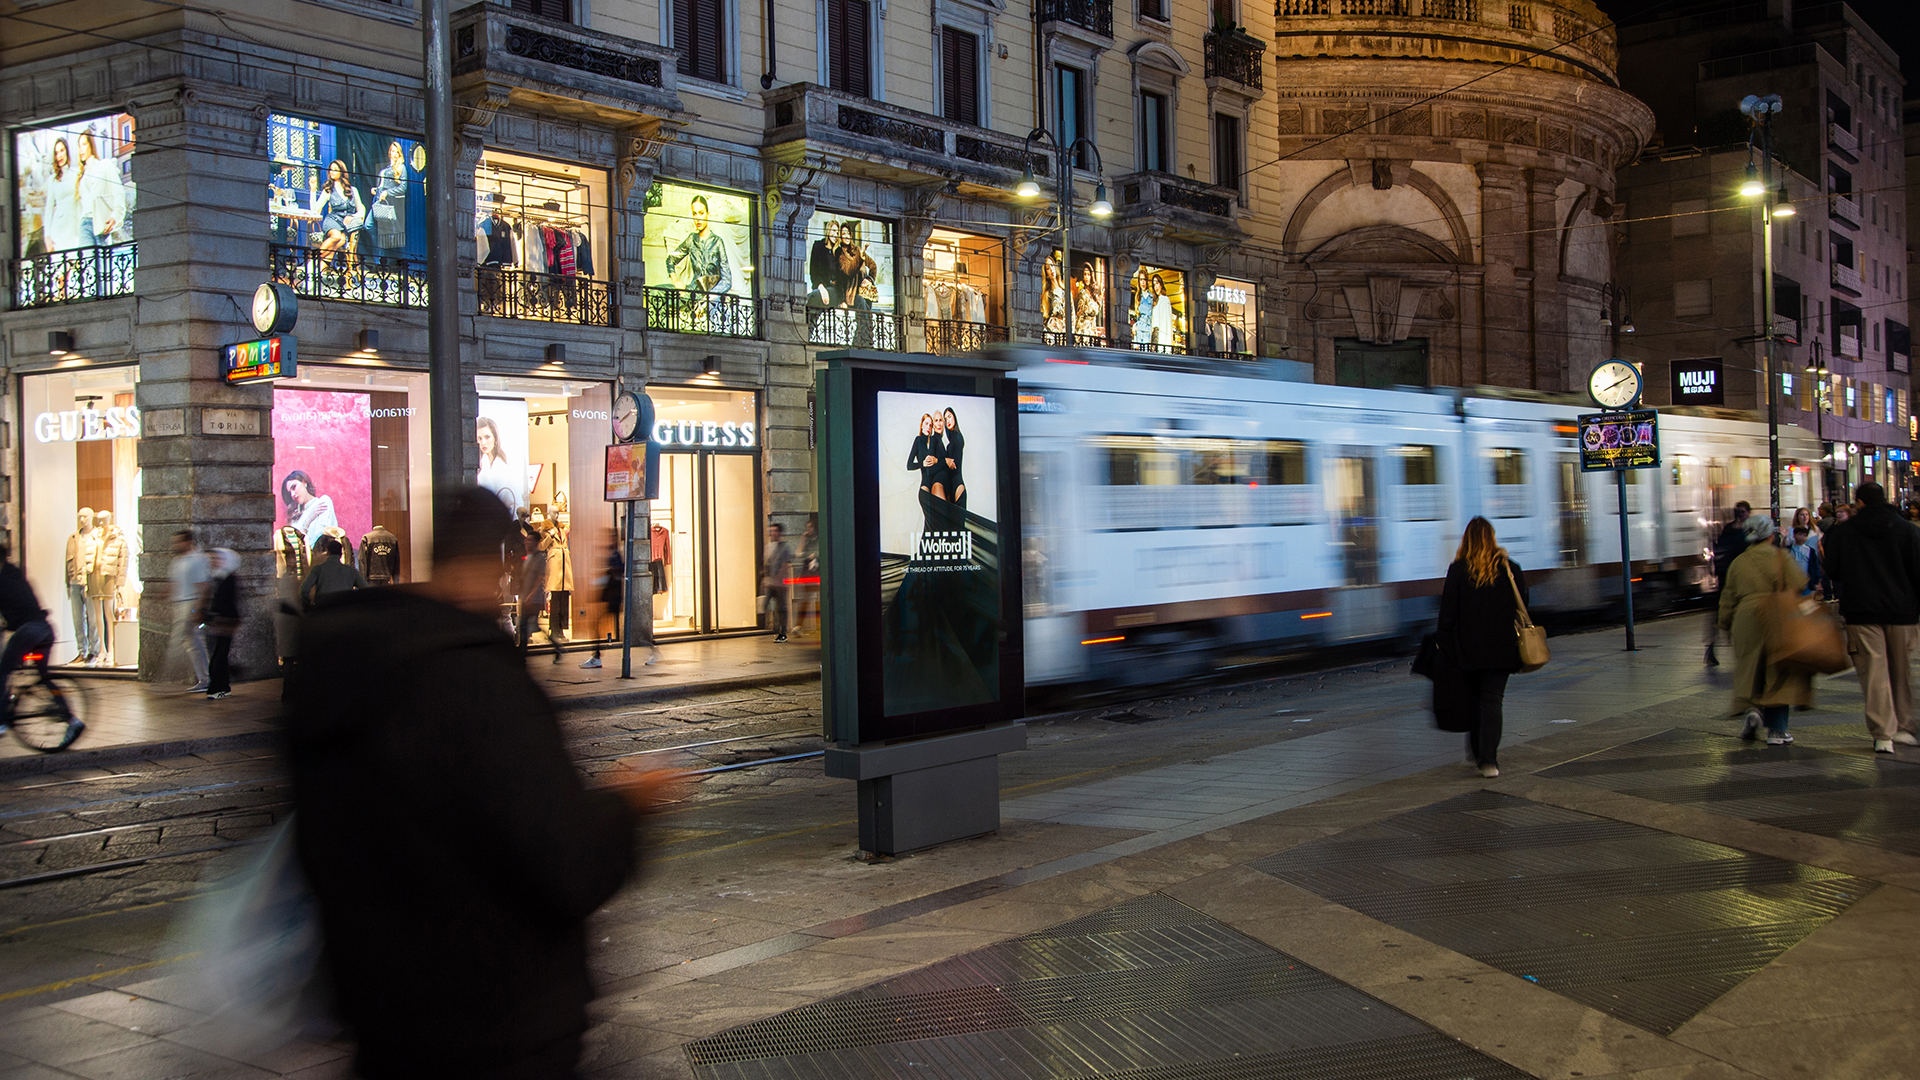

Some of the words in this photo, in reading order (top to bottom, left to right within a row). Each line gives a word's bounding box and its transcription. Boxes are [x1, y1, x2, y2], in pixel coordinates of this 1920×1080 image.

[1207, 285, 1246, 305] GUESS
[229, 341, 280, 367] POMET
[1679, 370, 1715, 386] MUJI
[34, 405, 141, 443] GUESS
[210, 422, 254, 430] TORINO
[652, 419, 755, 446] GUESS
[921, 538, 961, 553] Wolford
